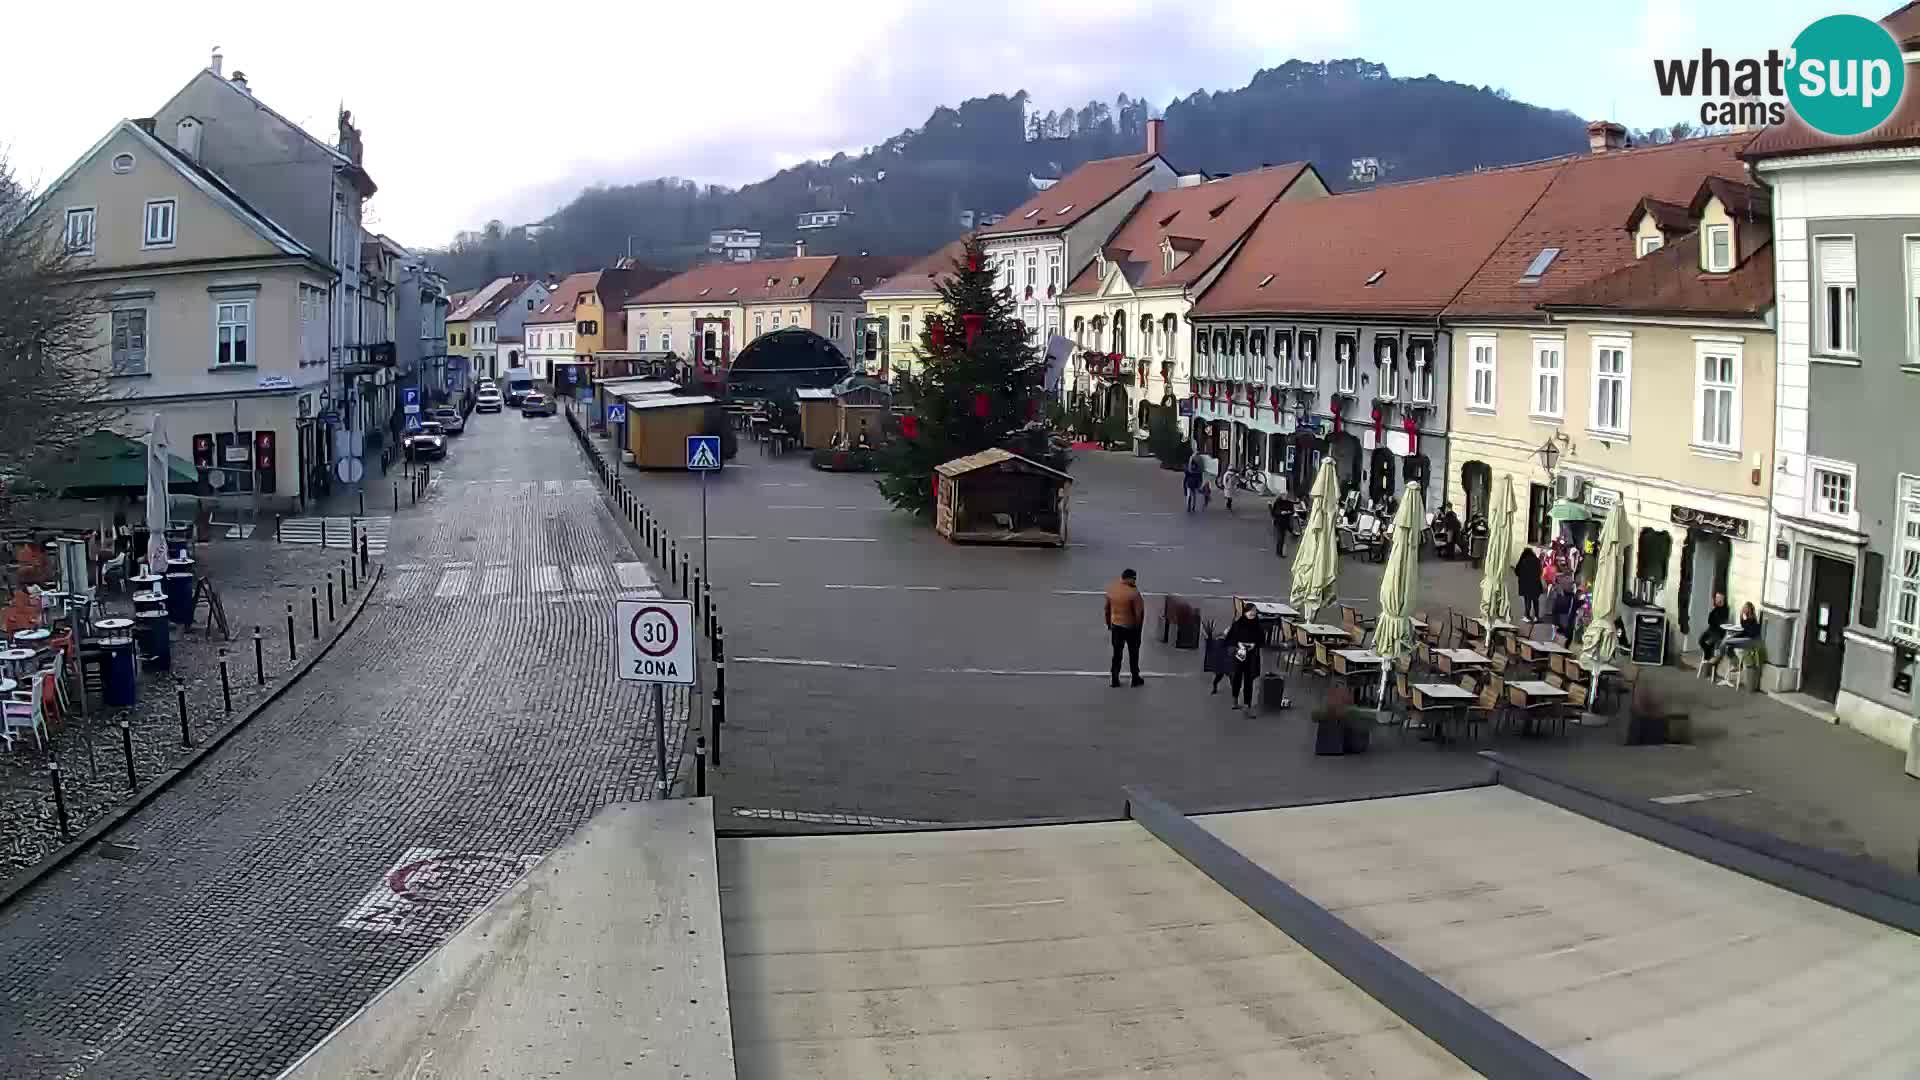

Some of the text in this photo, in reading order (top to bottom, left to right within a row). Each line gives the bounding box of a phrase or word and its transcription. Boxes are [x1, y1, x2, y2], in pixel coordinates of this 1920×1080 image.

[407, 391, 416, 402] P
[643, 622, 667, 643] 30
[633, 659, 678, 677] ZONA
